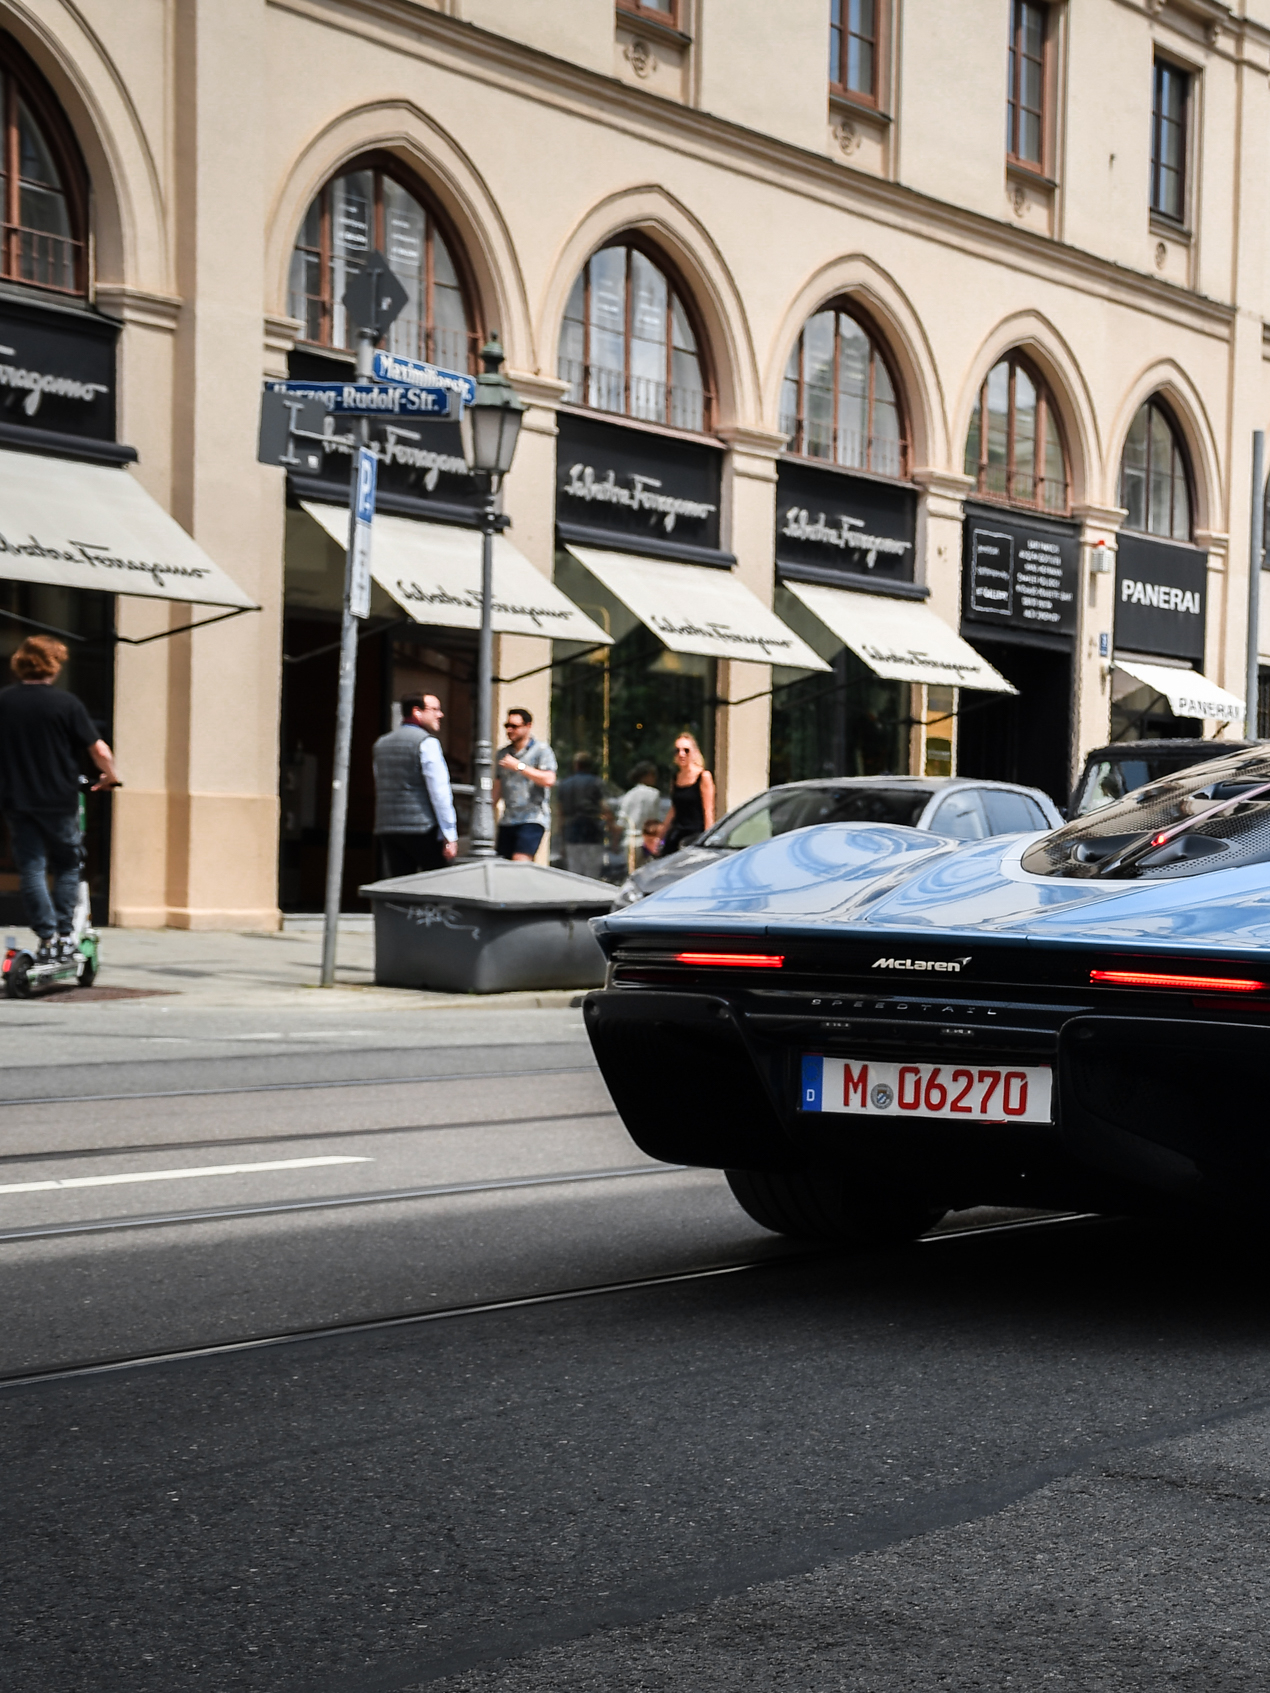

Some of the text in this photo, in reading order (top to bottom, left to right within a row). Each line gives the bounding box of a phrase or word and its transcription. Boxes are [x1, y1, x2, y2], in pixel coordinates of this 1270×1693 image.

[380, 424, 478, 491] Ferragam
[564, 463, 717, 533] Salvatore Ferragamo
[782, 506, 912, 569] Salvatore Ferragamo
[0, 532, 211, 588] lvatore Ferragamo
[464, 588, 574, 628] Frragamo
[1121, 578, 1200, 615] PANERAI
[1178, 697, 1240, 720] PANERAI
[871, 957, 961, 973] McLaren
[811, 998, 997, 1015] SPEEDTAIL
[806, 1089, 815, 1101] D
[842, 1063, 1028, 1116] M 06270
